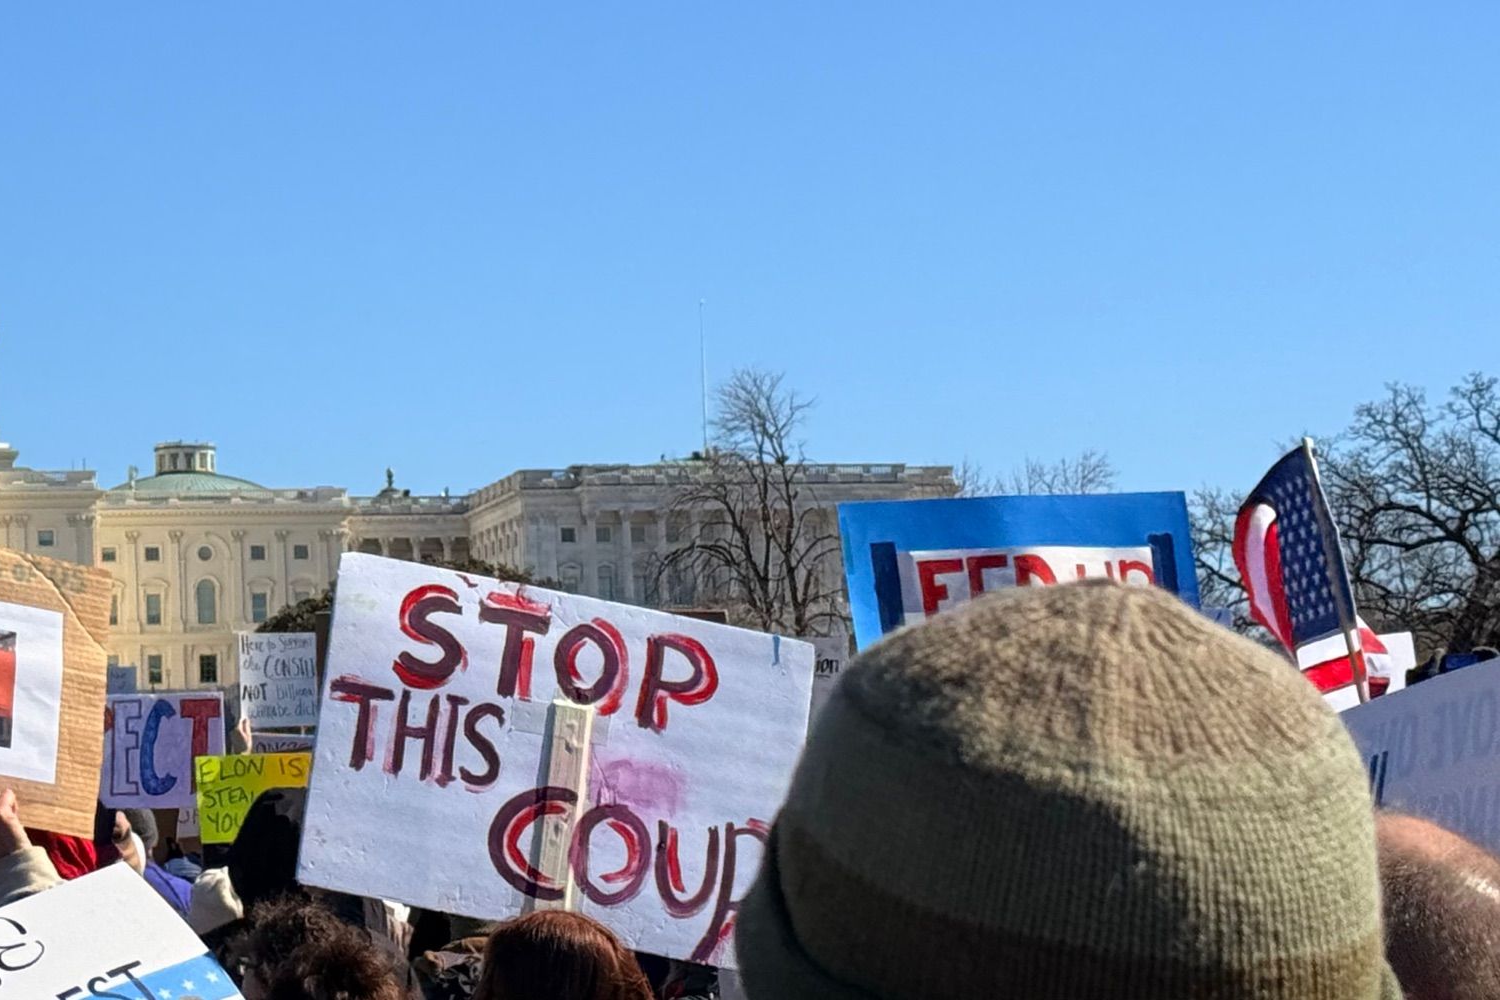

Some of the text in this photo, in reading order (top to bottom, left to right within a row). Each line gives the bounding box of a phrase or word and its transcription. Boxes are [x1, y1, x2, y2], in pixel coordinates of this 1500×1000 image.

[393, 583, 719, 733] STOP
[200, 756, 303, 785] ELON IS
[330, 675, 506, 793] THIS
